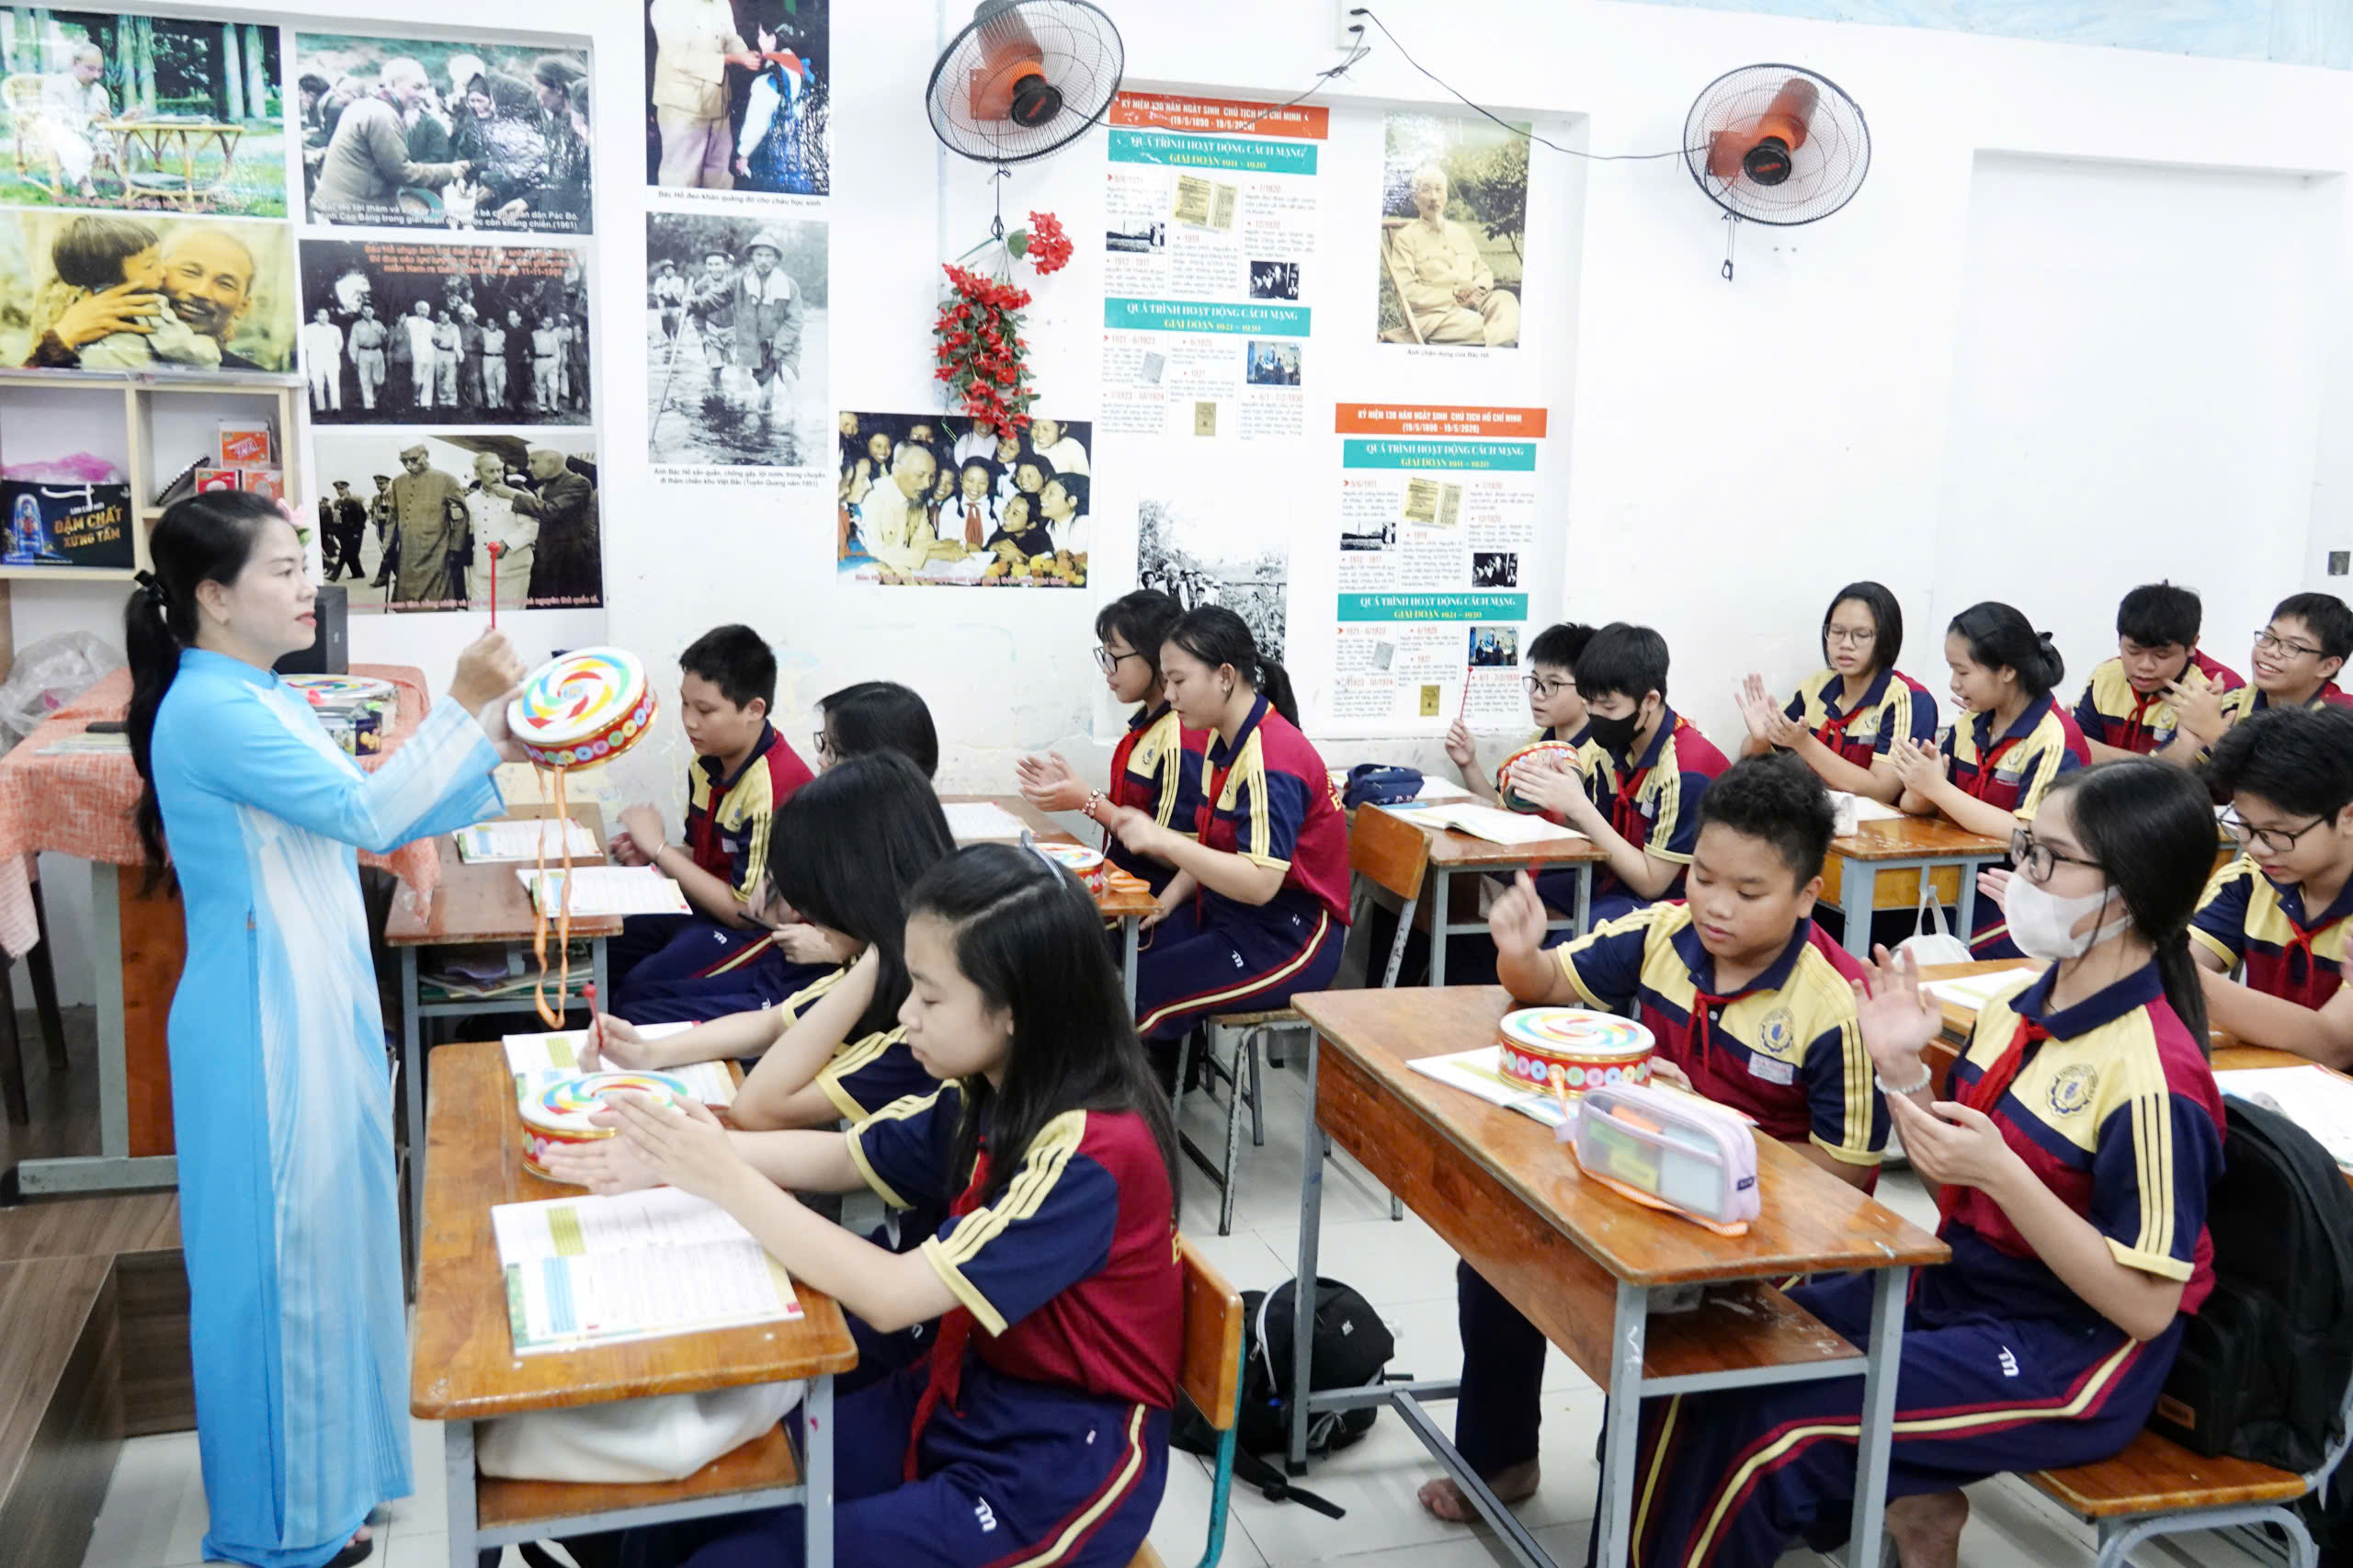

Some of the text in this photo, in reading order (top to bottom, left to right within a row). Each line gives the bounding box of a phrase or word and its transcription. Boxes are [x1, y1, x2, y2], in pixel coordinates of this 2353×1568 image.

[1165, 100, 1181, 113] NĂM
[1183, 102, 1202, 115] NGÀY
[1203, 106, 1220, 116] SINH
[1223, 106, 1239, 117] CHỦ
[1240, 108, 1257, 119] TỊCH
[1269, 108, 1282, 121] CHÍ
[1283, 112, 1302, 122] MINH
[1154, 136, 1186, 150] TRÌNH
[1186, 139, 1216, 155] HOẠT
[1216, 139, 1245, 155] ĐỘNG
[1246, 142, 1272, 156] CÁCH
[1273, 145, 1305, 160] MẠNG
[658, 190, 671, 199] Bác
[674, 191, 685, 199] Hồ
[772, 198, 790, 206] cháu
[381, 214, 404, 226] trong
[1127, 301, 1299, 324] QUÁ TRÌNH HOẠT ĐỘNG CÁCH MẠNG
[1164, 319, 1184, 329] GIAI
[1185, 319, 1215, 333] ĐOẠN
[1438, 350, 1453, 358] dung
[1368, 409, 1384, 422] NIỆM
[1385, 411, 1397, 420] 130
[1398, 410, 1413, 421] NĂM
[1414, 410, 1431, 421] NGÀY
[1432, 412, 1448, 421] SINH
[1450, 412, 1465, 422] CHỦ
[1466, 413, 1482, 424] TỊCH
[1482, 412, 1492, 423] HỒ
[1493, 413, 1505, 423] CHÍ
[1505, 414, 1522, 424] MINH
[1366, 441, 1525, 459] QUÁ TRÌNH HOẠT ĐỘNG CÁCH MẠNG
[1400, 458, 1420, 467] GIAI
[1419, 458, 1448, 470] ĐOẠN
[766, 479, 786, 488] Quang
[786, 472, 802, 480] trong
[53, 515, 85, 535] ĐẬM
[1359, 593, 1517, 609] QUÁ TRÌNH HOẠT ĐỘNG CÁCH MẠNG
[1393, 609, 1414, 619] GIAI
[1413, 609, 1440, 621] ĐOẠN
